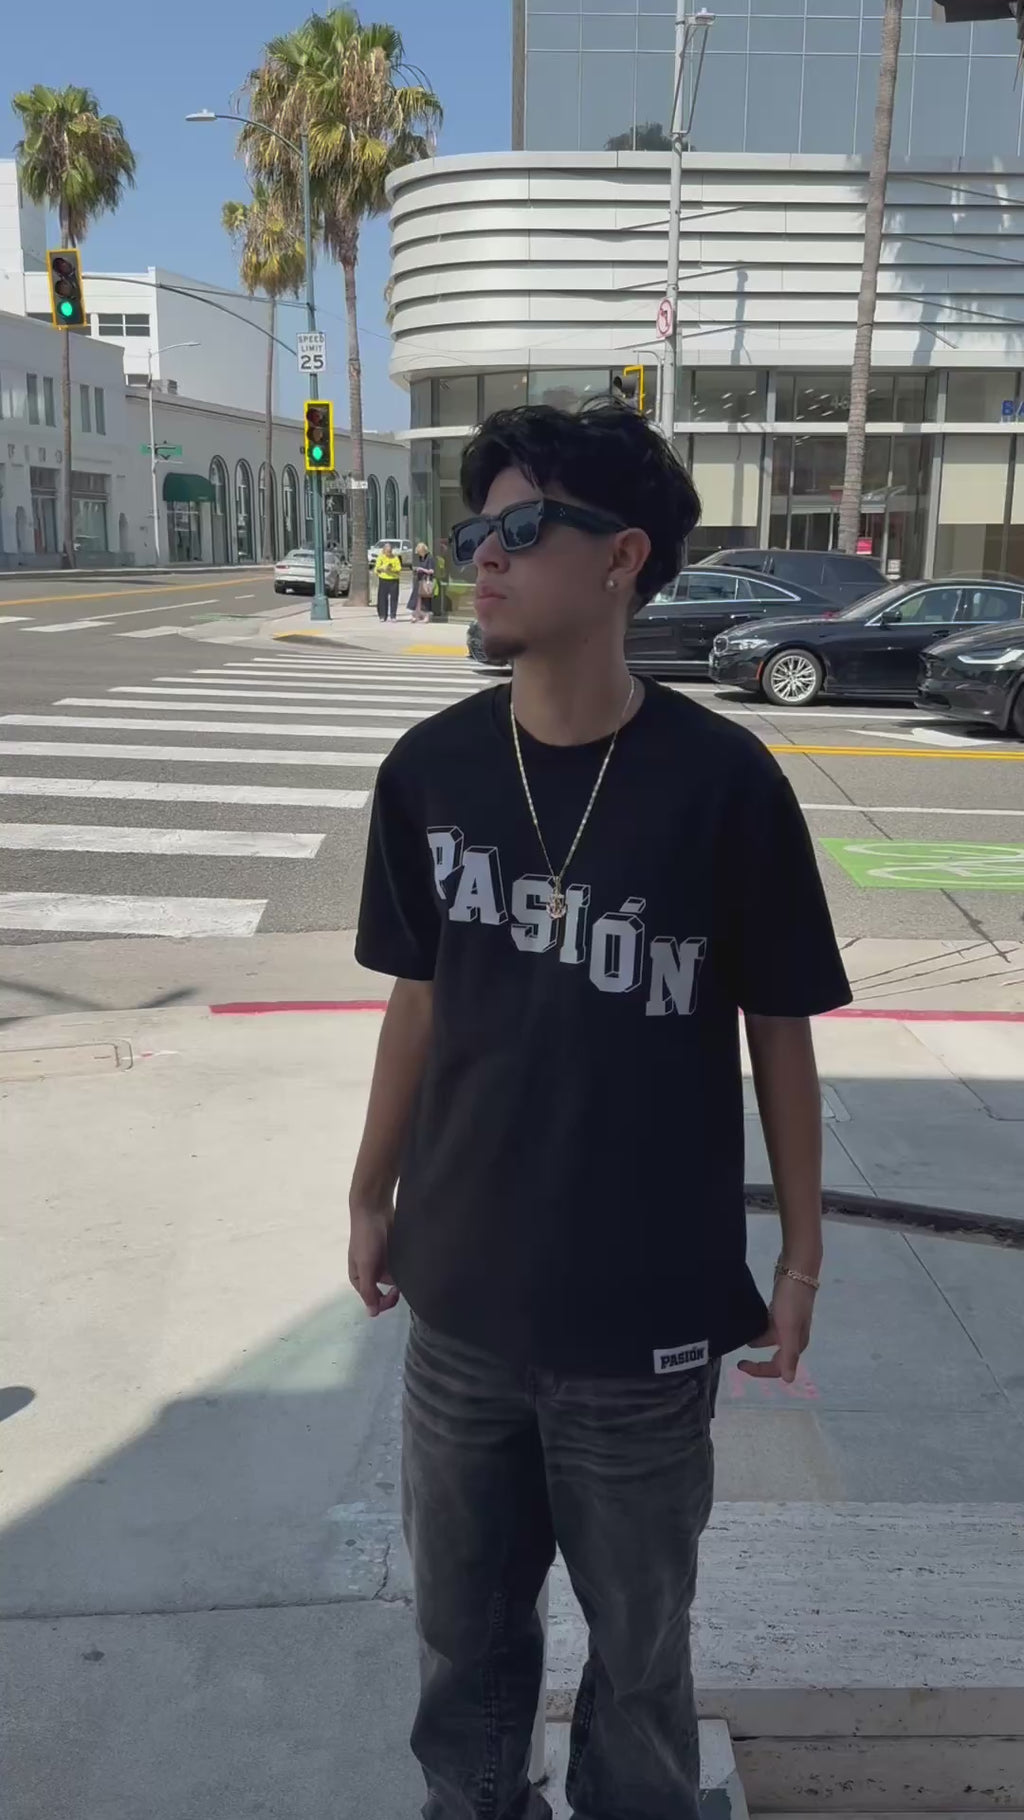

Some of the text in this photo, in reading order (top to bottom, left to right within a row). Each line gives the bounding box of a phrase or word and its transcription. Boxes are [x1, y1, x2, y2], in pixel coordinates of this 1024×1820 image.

[298, 335, 324, 343] SPEED
[301, 355, 324, 369] 25
[427, 826, 707, 1016] PASIÓN
[660, 1346, 705, 1370] PASIÓN
